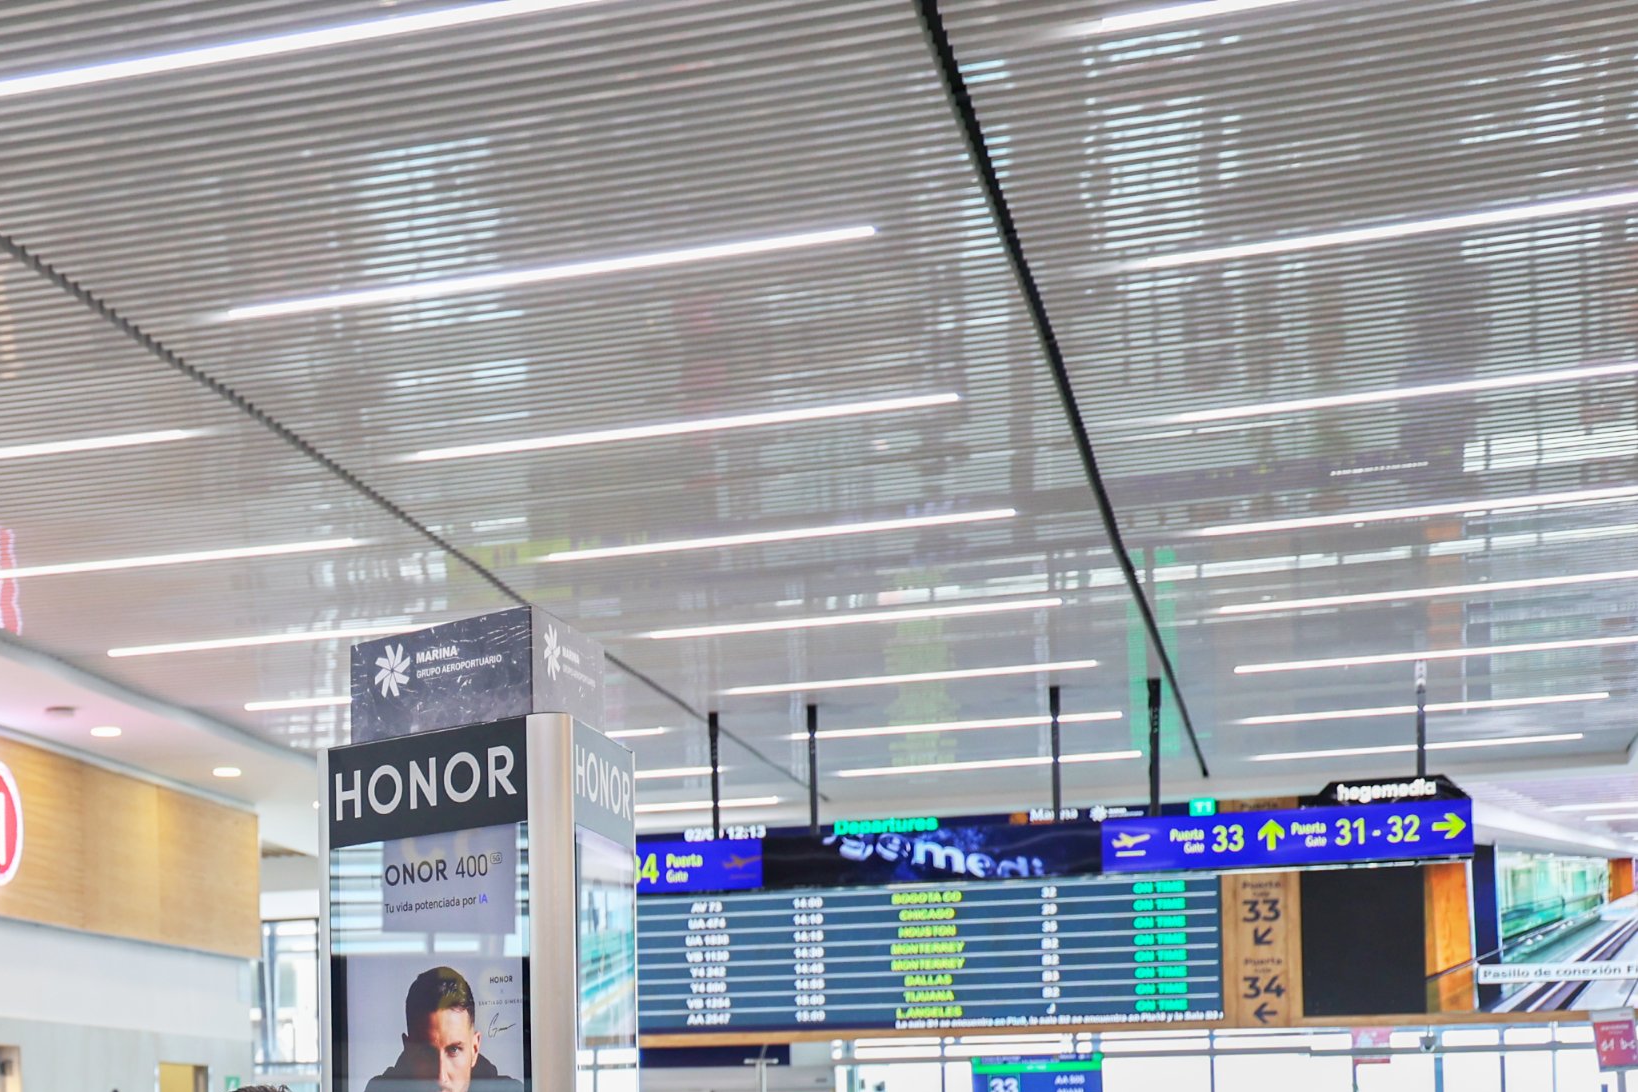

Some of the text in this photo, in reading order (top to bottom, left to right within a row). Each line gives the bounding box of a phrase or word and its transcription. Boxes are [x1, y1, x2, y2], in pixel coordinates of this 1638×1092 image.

[416, 645, 458, 664] MARINA
[416, 654, 502, 679] GRUPO AEROPORTUARIO
[335, 745, 518, 821] HONOR
[575, 744, 631, 822] HONOR
[834, 816, 939, 836] Departures
[1291, 821, 1327, 837] Puerta
[1335, 818, 1366, 846] 31
[1386, 815, 1420, 843] 32
[1169, 824, 1244, 852] Puerta 33
[385, 858, 448, 886] ONOR
[455, 854, 488, 878] 400
[666, 854, 703, 868] Puerta
[385, 894, 488, 913] Tu vida potenciada por IA
[891, 891, 942, 905] BOGOTA
[899, 908, 955, 921] CHICAGO
[1242, 899, 1280, 923] 33
[898, 924, 957, 938] HOUSTON
[891, 941, 965, 955] MONTERREY
[891, 957, 965, 971] MONTERREY
[1483, 967, 1529, 978] Pasillo
[1534, 966, 1551, 977] de
[1556, 965, 1621, 977] conexión
[490, 975, 513, 984] HONOR
[904, 974, 953, 987] DALLAS
[1243, 975, 1285, 999] 34
